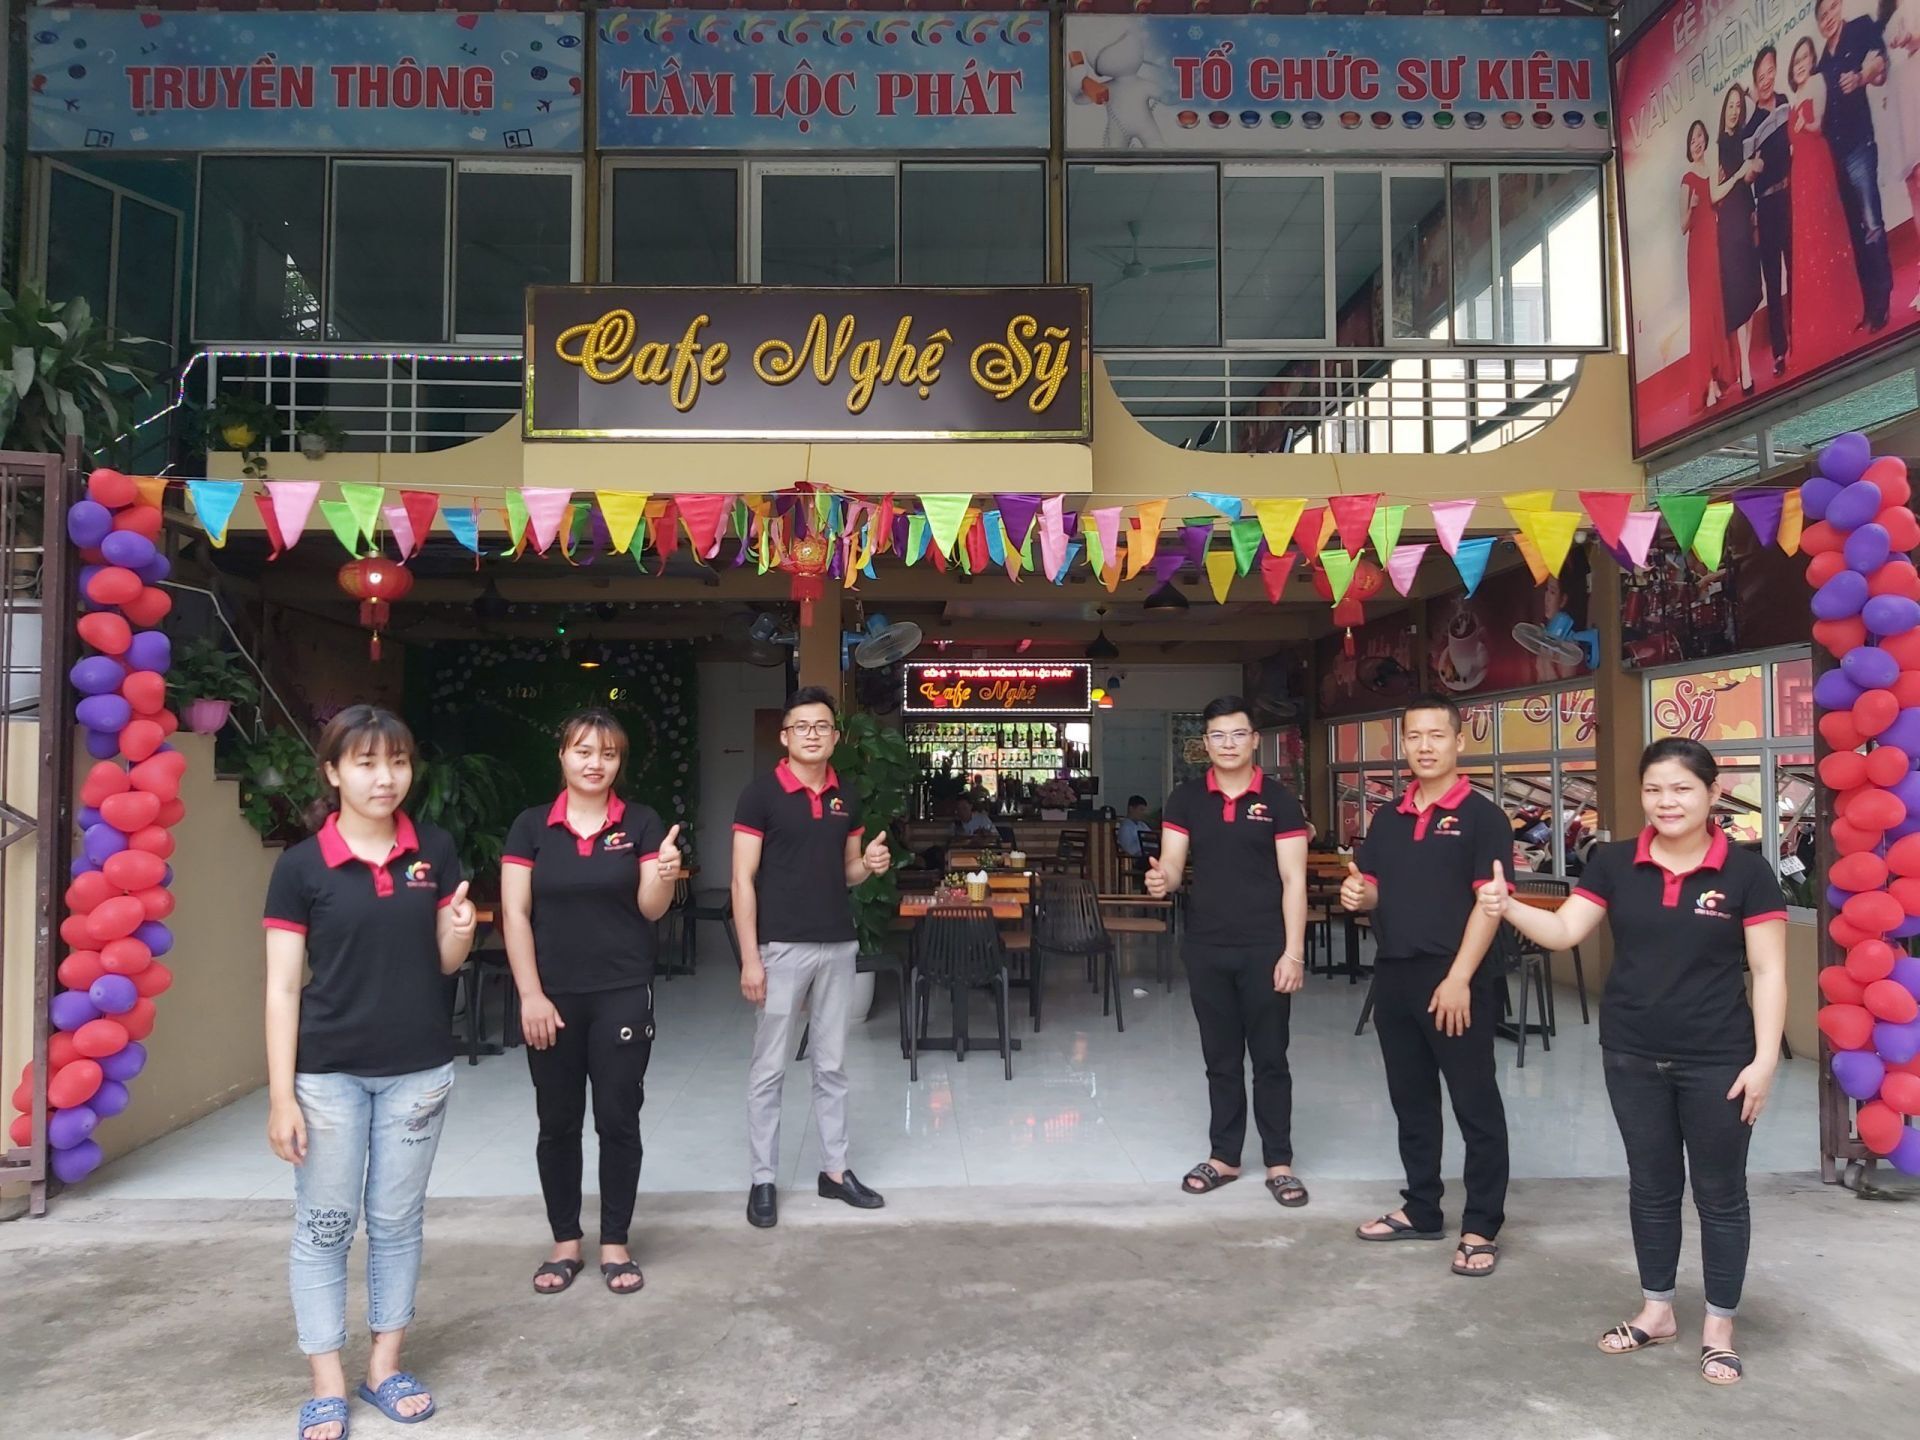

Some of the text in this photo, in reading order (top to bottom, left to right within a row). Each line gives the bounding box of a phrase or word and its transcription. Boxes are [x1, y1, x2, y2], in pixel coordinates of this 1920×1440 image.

[125, 52, 494, 109] TRUYỀN THÔNG
[620, 57, 1023, 133] TÂM LỘC PHÁT
[1173, 41, 1592, 110] TỔ CHỨC SỰ KIỆN
[555, 308, 1071, 414] Cafe Nghệ Sỹ
[1653, 679, 1716, 741] Sỹ
